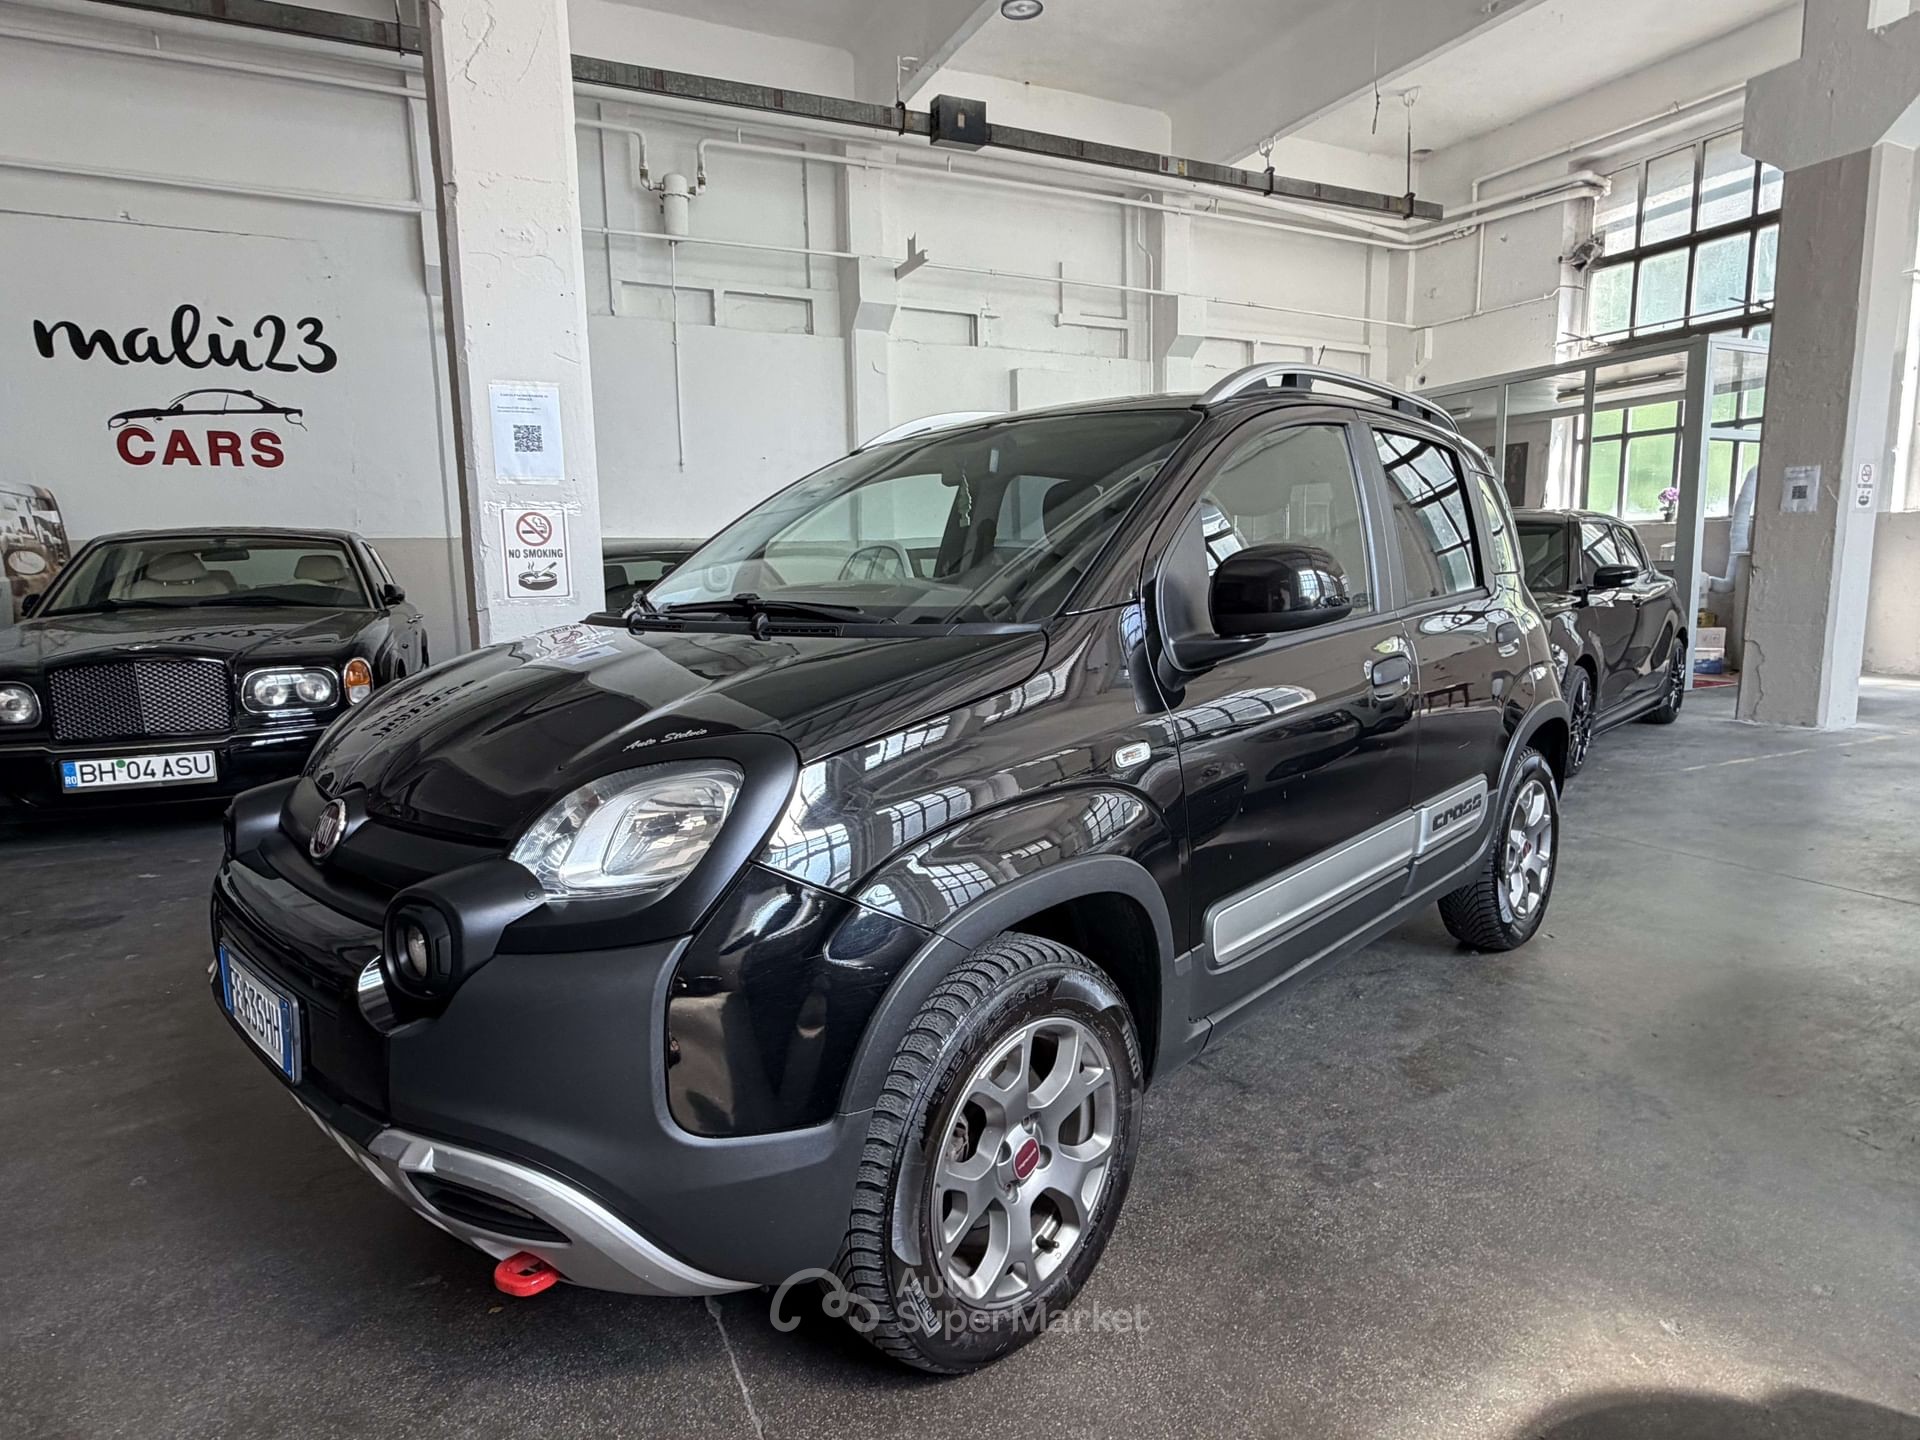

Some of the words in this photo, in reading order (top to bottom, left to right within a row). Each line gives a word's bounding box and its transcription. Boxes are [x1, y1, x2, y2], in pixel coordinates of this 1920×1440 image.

[117, 426, 285, 468] CARS
[508, 549, 521, 559] NO
[523, 548, 563, 559] SMOKING
[79, 762, 117, 784] BH
[126, 760, 156, 780] 04
[162, 755, 211, 777] ASU
[65, 775, 77, 785] RO
